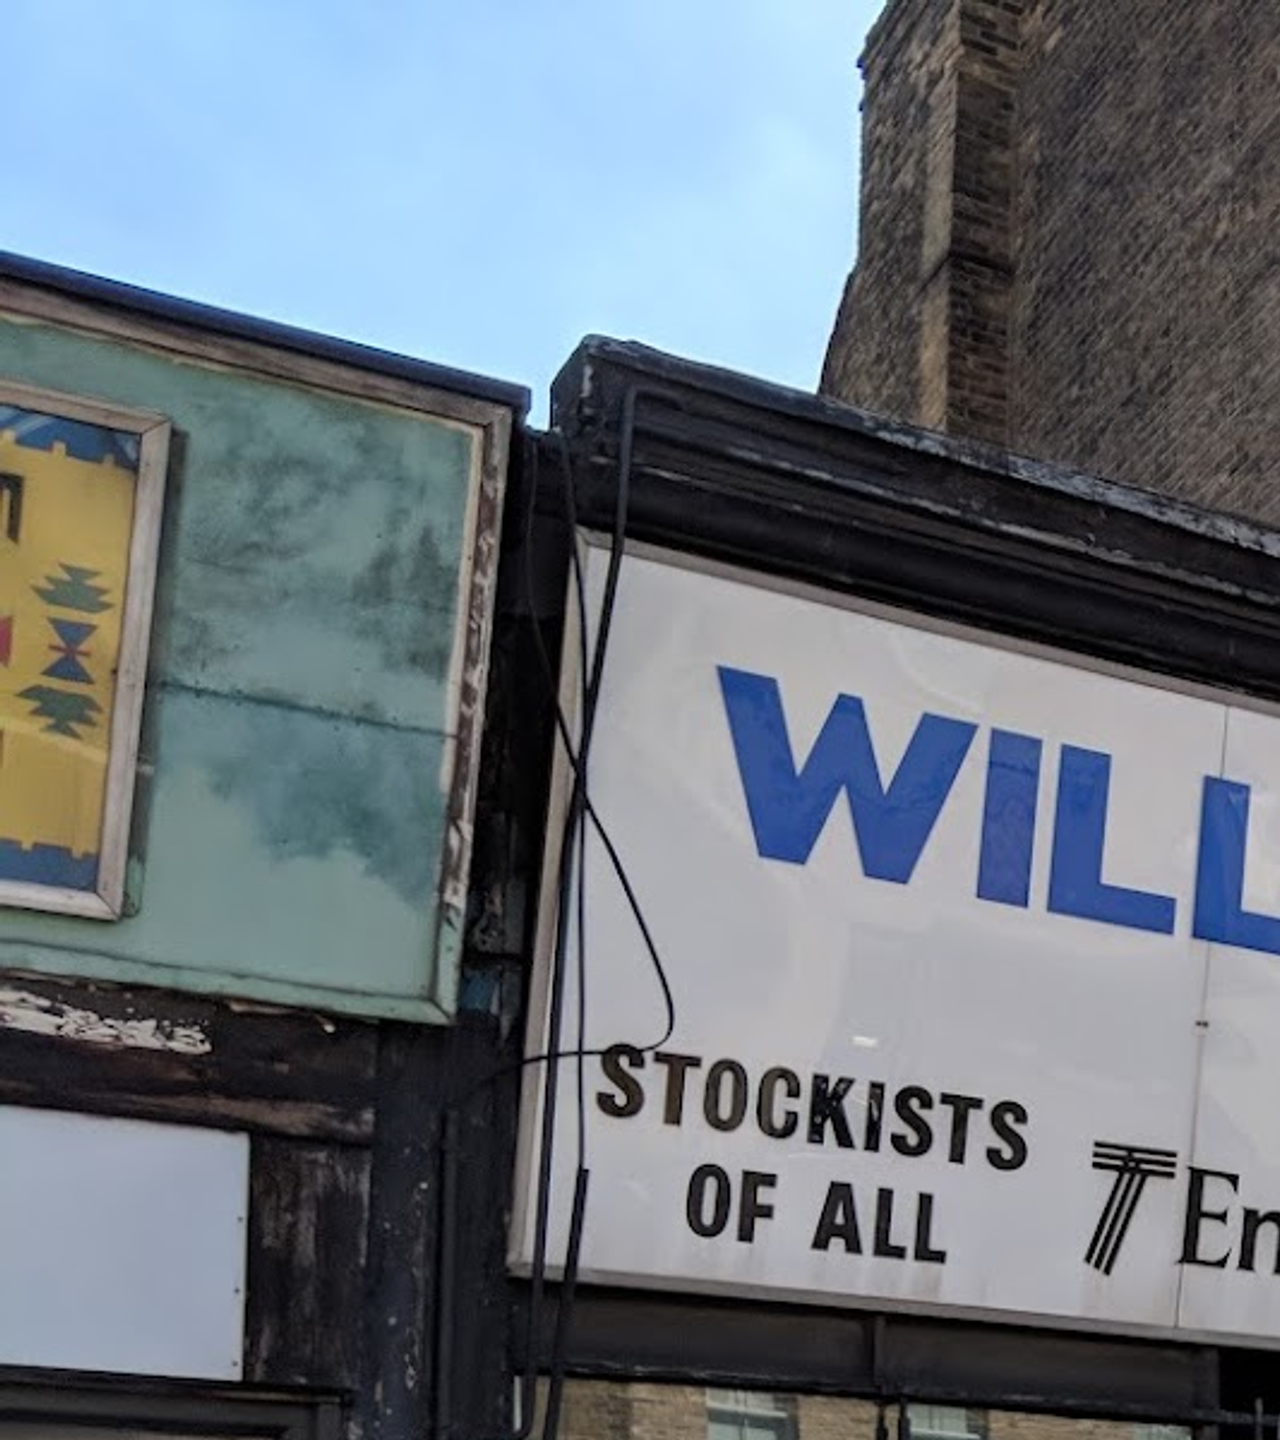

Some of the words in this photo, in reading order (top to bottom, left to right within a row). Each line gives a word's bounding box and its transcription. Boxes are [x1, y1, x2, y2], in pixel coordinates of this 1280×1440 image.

[595, 1042, 1029, 1171] STOCKISTS
[685, 1163, 778, 1243] OF
[811, 1181, 948, 1264] ALL
